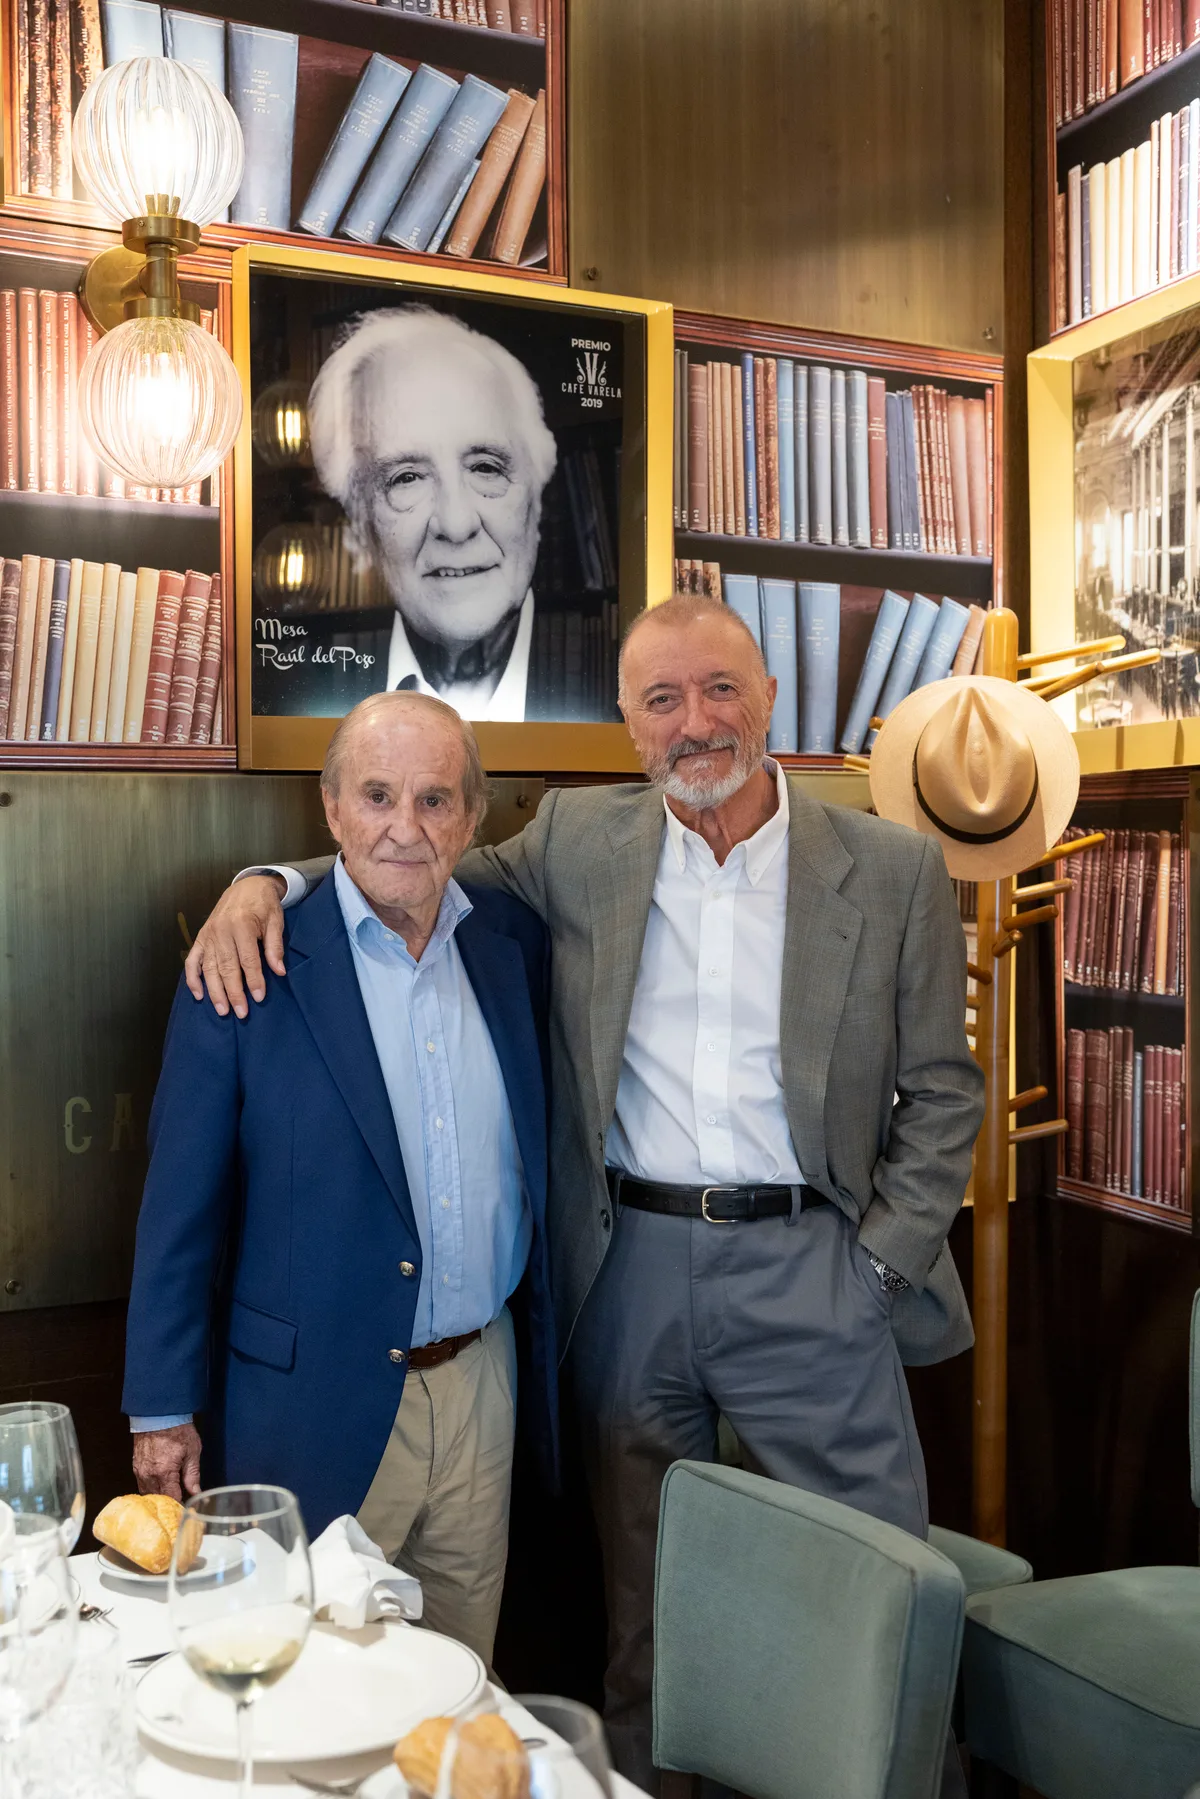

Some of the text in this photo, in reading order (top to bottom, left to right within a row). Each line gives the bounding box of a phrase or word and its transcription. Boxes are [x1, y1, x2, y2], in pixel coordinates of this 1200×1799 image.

[571, 338, 611, 352] PREMIO
[587, 385, 622, 398] VARELA
[581, 397, 603, 408] 2019
[255, 618, 308, 640] Mesa
[255, 644, 376, 672] Raúl del Pozo
